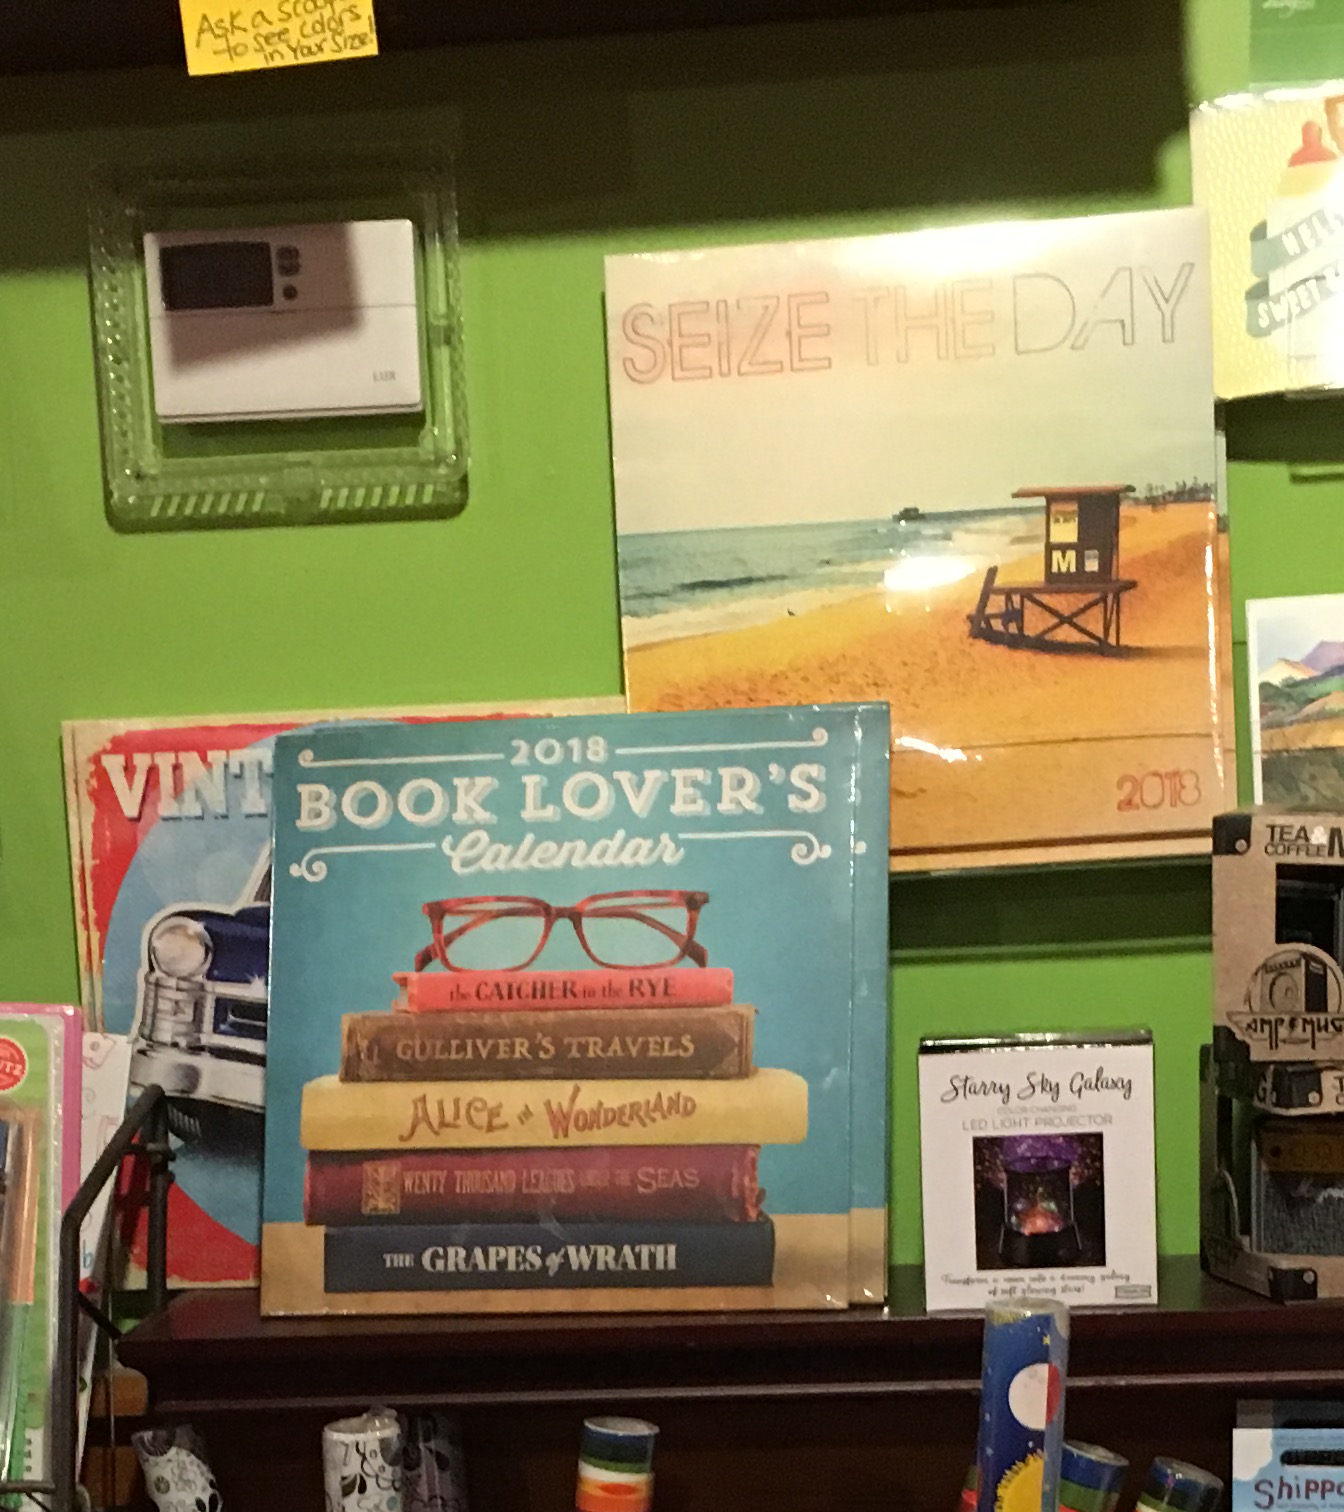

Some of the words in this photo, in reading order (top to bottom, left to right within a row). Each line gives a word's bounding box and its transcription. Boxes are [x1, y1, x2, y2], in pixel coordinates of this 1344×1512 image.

[195, 10, 248, 48] Ask
[251, 9, 273, 29] a
[213, 32, 248, 63] to
[253, 27, 291, 54] see
[263, 48, 285, 66] in
[621, 291, 833, 385] SEIZE
[854, 277, 997, 366] THE
[1013, 261, 1196, 356] DAY
[510, 736, 610, 768] 2018
[101, 749, 275, 824] VINT
[295, 775, 499, 834] BOOK
[519, 763, 829, 826] LOVER'S
[1116, 769, 1203, 812] 2018
[1264, 841, 1328, 858] COFFEE
[1265, 824, 1312, 844] TEA
[441, 828, 686, 875] Calendar
[474, 979, 578, 1002] CATCHER
[628, 976, 677, 998] RYE
[395, 1031, 556, 1062] GULLIVER'S
[566, 1034, 696, 1059] TRAVELS
[940, 1073, 1011, 1104] Starry
[1017, 1071, 1061, 1104] Sky
[1069, 1066, 1133, 1101] Galaxy
[398, 1093, 509, 1143] ALICE
[542, 1083, 698, 1140] WONDERLAND
[962, 1119, 988, 1132] LED
[992, 1117, 1030, 1130] LIGHT
[1034, 1113, 1113, 1128] PROJECTOR
[455, 1169, 516, 1195] THOUSAND
[635, 1165, 701, 1194] SEAS
[383, 1252, 415, 1268] THE
[421, 1243, 544, 1273] GRAPES
[565, 1242, 678, 1272] WRATH
